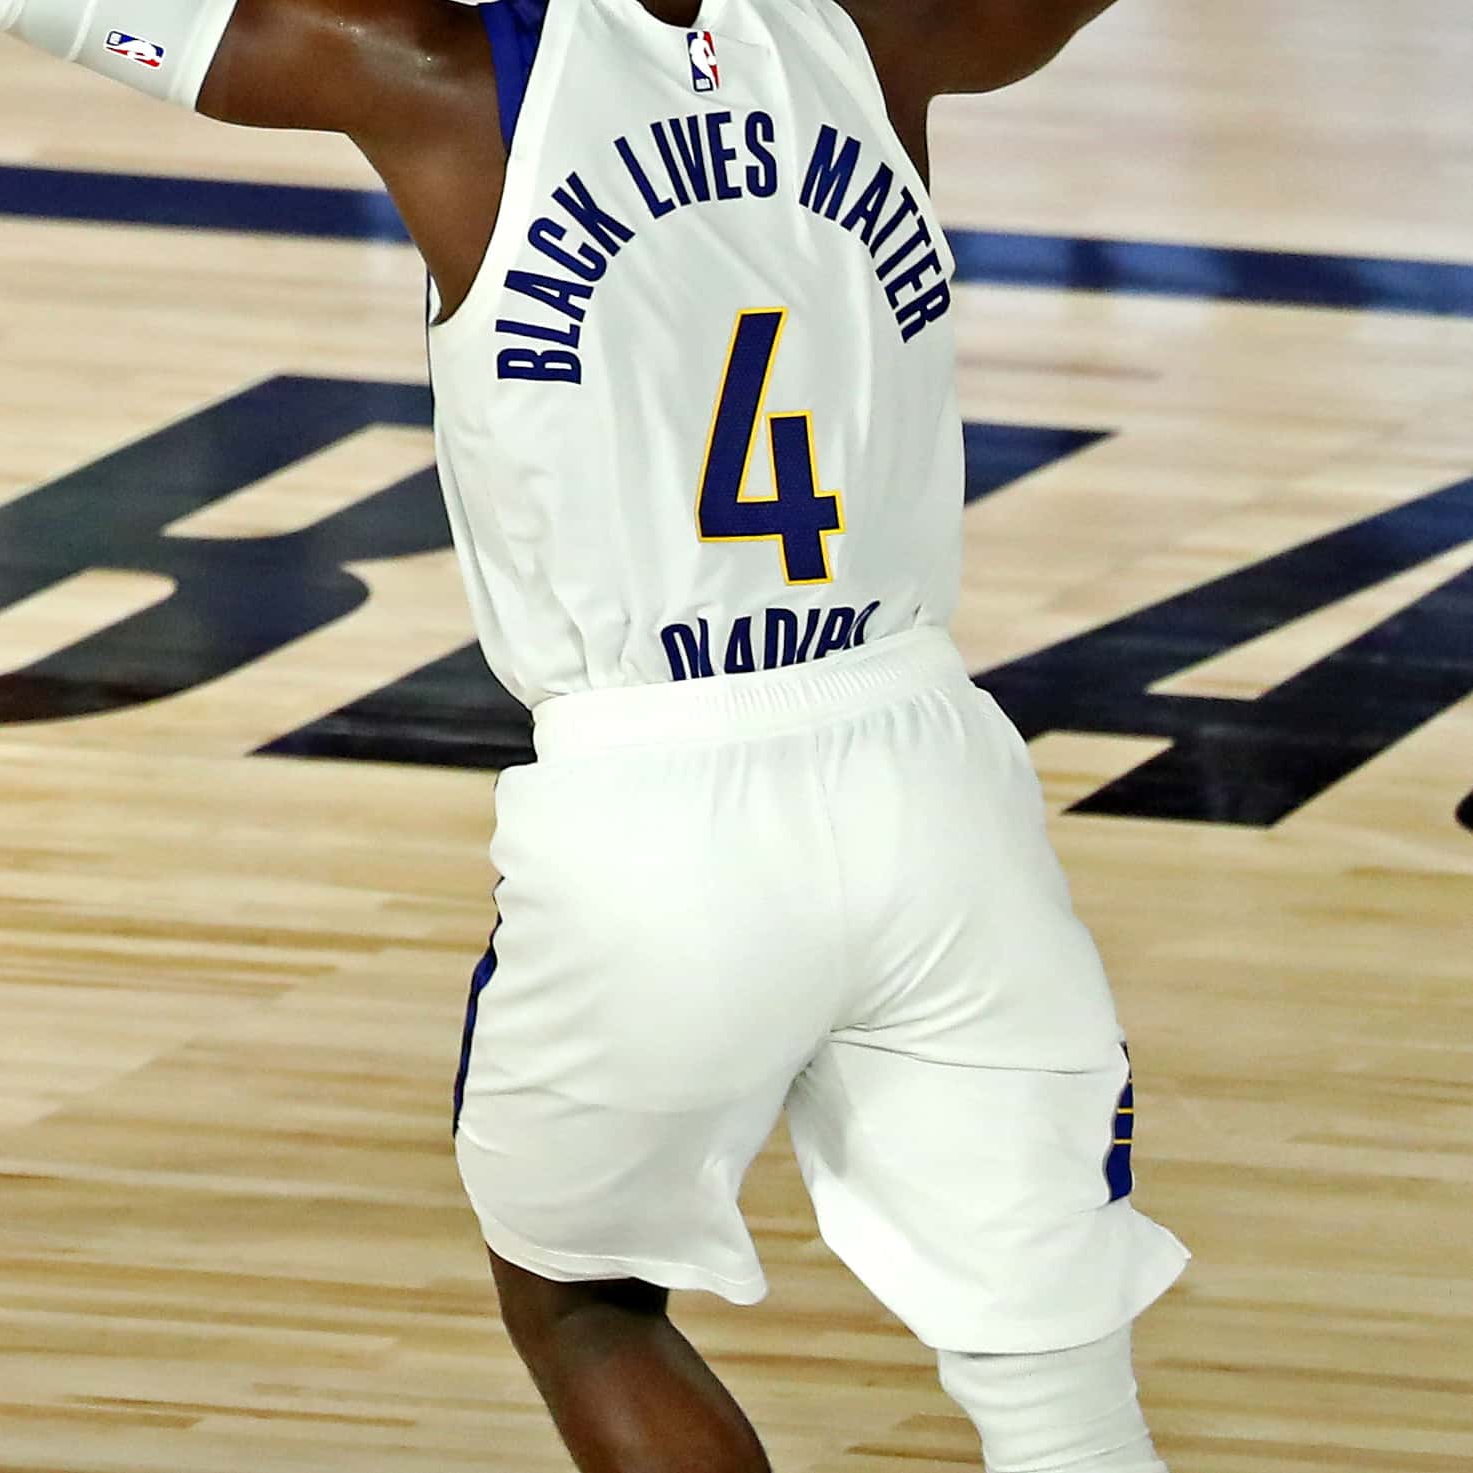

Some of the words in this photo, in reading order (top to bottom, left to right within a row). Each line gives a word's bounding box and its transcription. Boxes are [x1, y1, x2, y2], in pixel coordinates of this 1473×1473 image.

[495, 171, 635, 384] BLACK
[614, 110, 779, 219] LIVES
[798, 124, 952, 343] MATTER
[696, 307, 845, 586] 4
